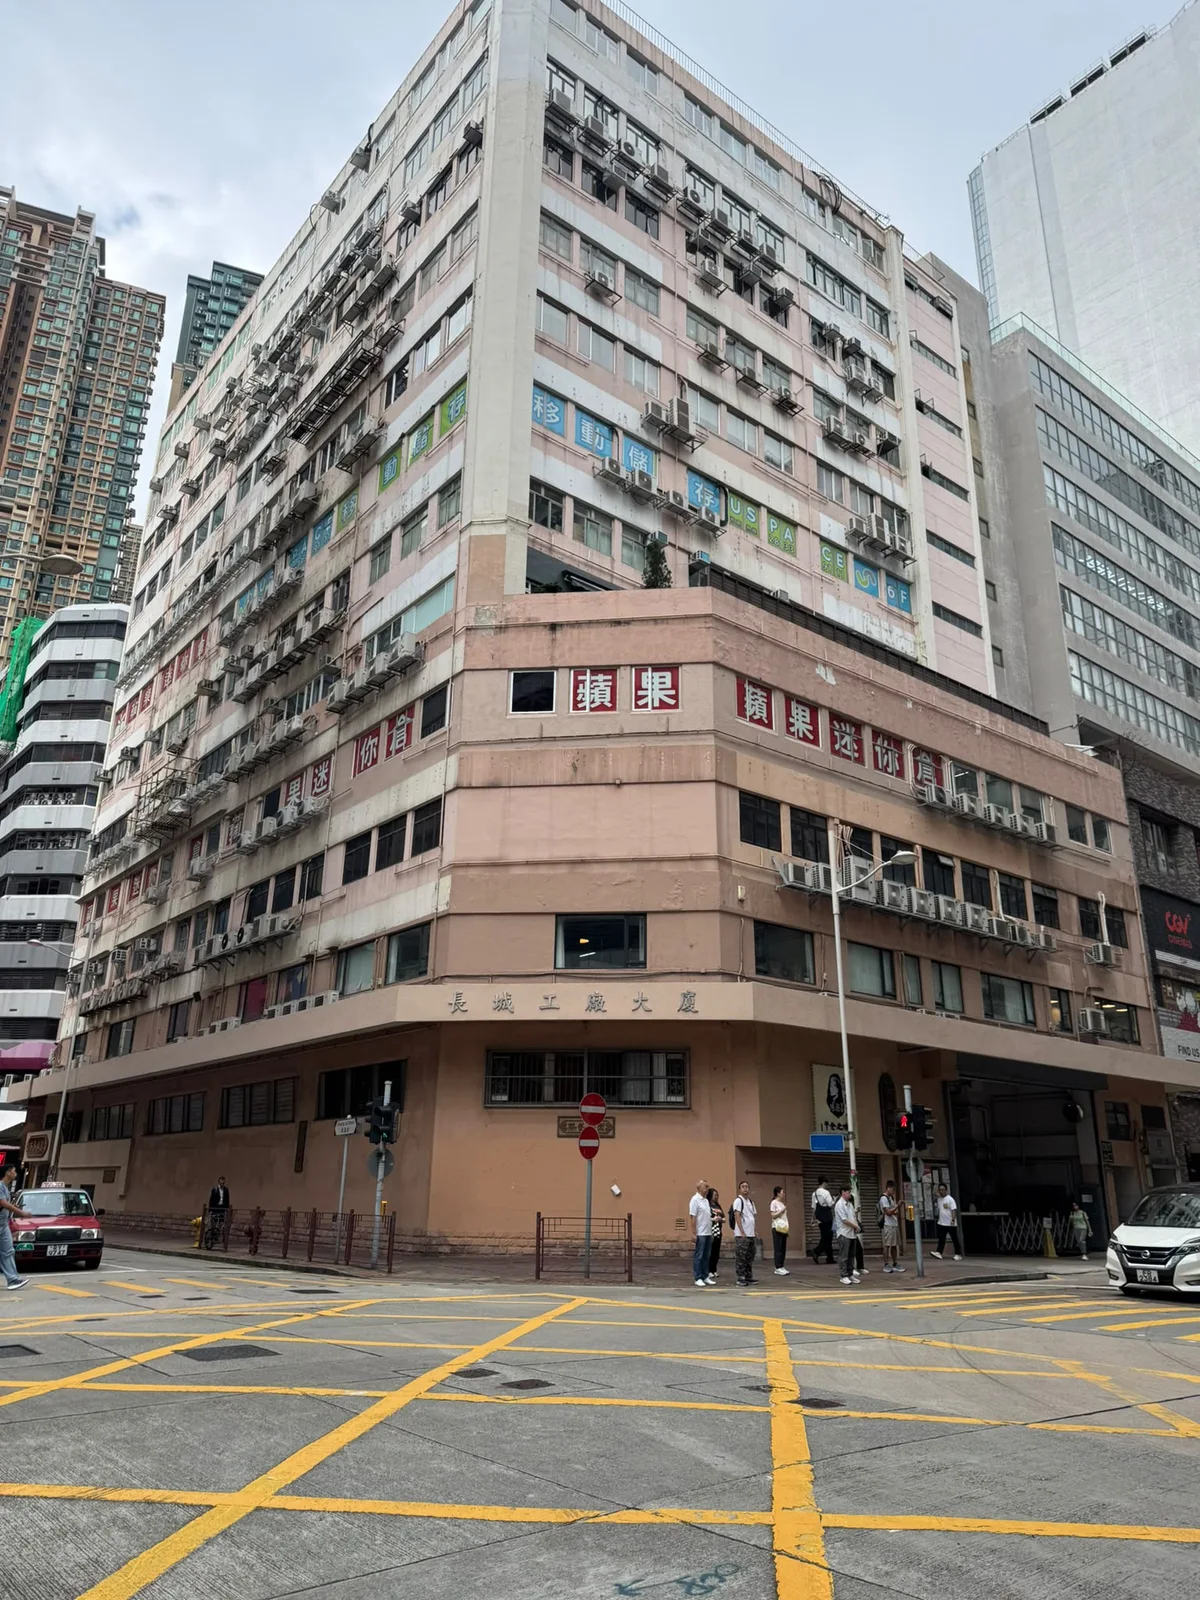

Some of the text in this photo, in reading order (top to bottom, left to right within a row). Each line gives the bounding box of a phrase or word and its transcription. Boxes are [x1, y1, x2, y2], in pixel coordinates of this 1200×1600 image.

[576, 672, 677, 708] 蘋果
[744, 683, 937, 785] 蘋果迷你倉
[1165, 911, 1189, 936] CGV
[448, 990, 699, 1015] 長城工廠大廈
[1178, 1044, 1191, 1056] FIND
